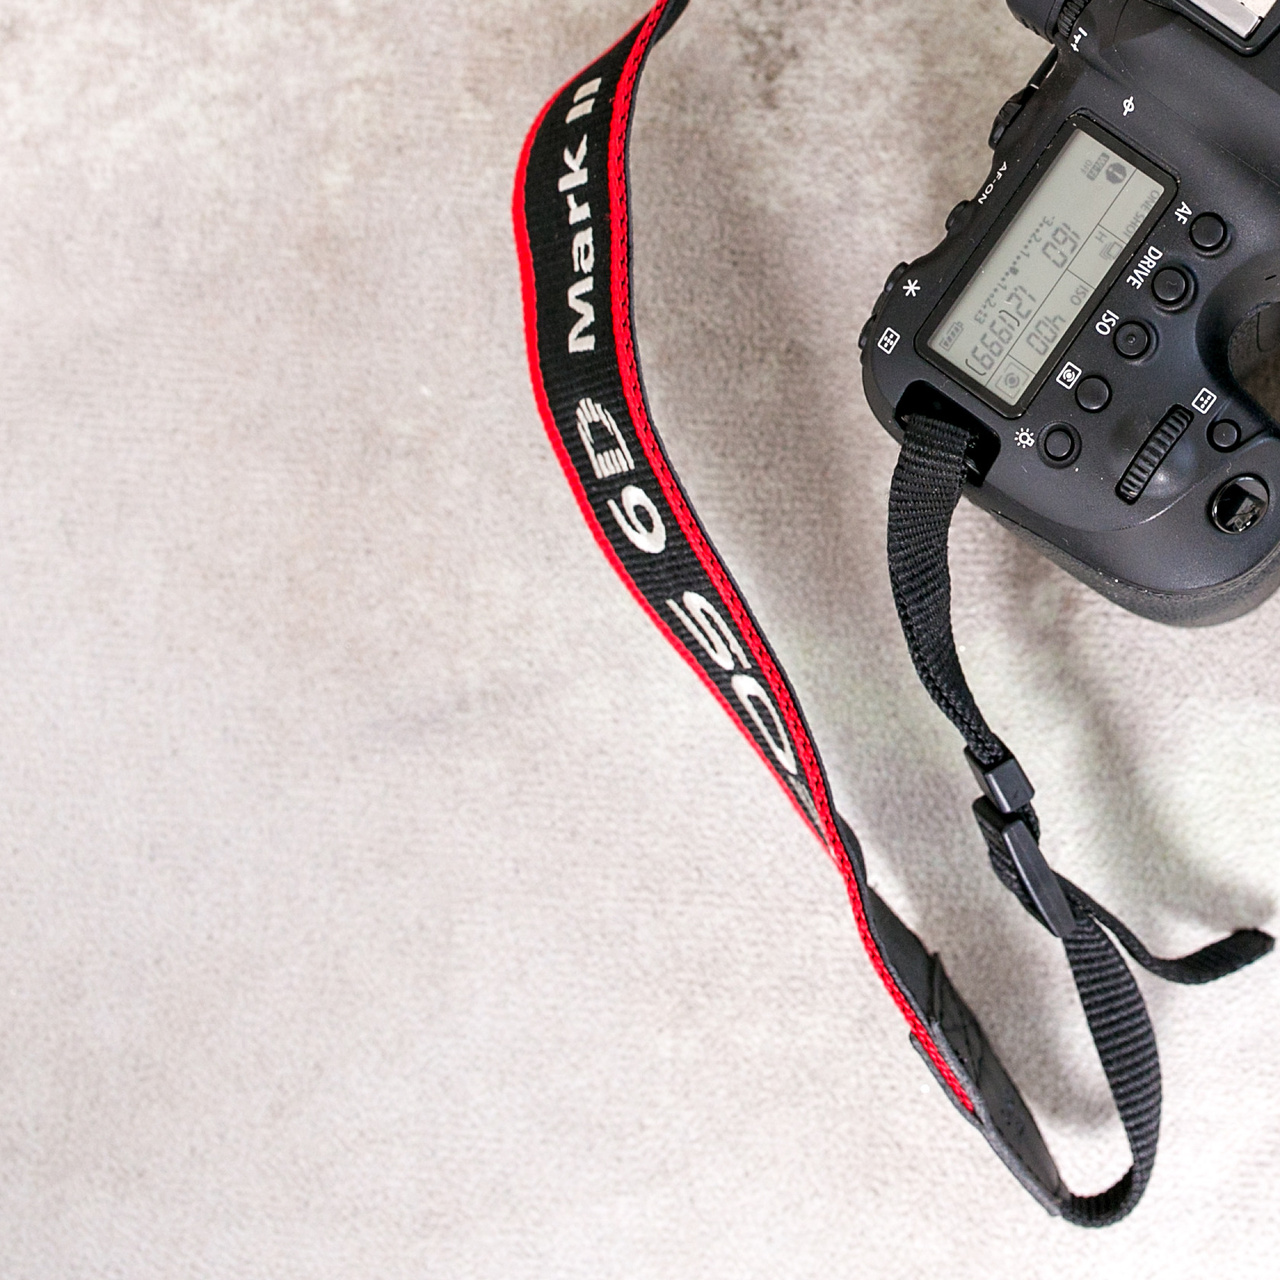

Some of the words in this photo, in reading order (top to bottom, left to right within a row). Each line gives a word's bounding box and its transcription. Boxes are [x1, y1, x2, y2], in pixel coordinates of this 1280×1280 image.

[977, 161, 1008, 205] AF-ON
[1174, 201, 1193, 225] AF
[557, 133, 596, 354] Mark
[1042, 222, 1081, 269] 160
[1094, 231, 1107, 243] H
[1126, 245, 1163, 290] DRIVE
[1069, 285, 1089, 307] ISO
[1026, 315, 1066, 357] 400
[1095, 309, 1120, 336] ISO
[576, 397, 666, 554] 6D
